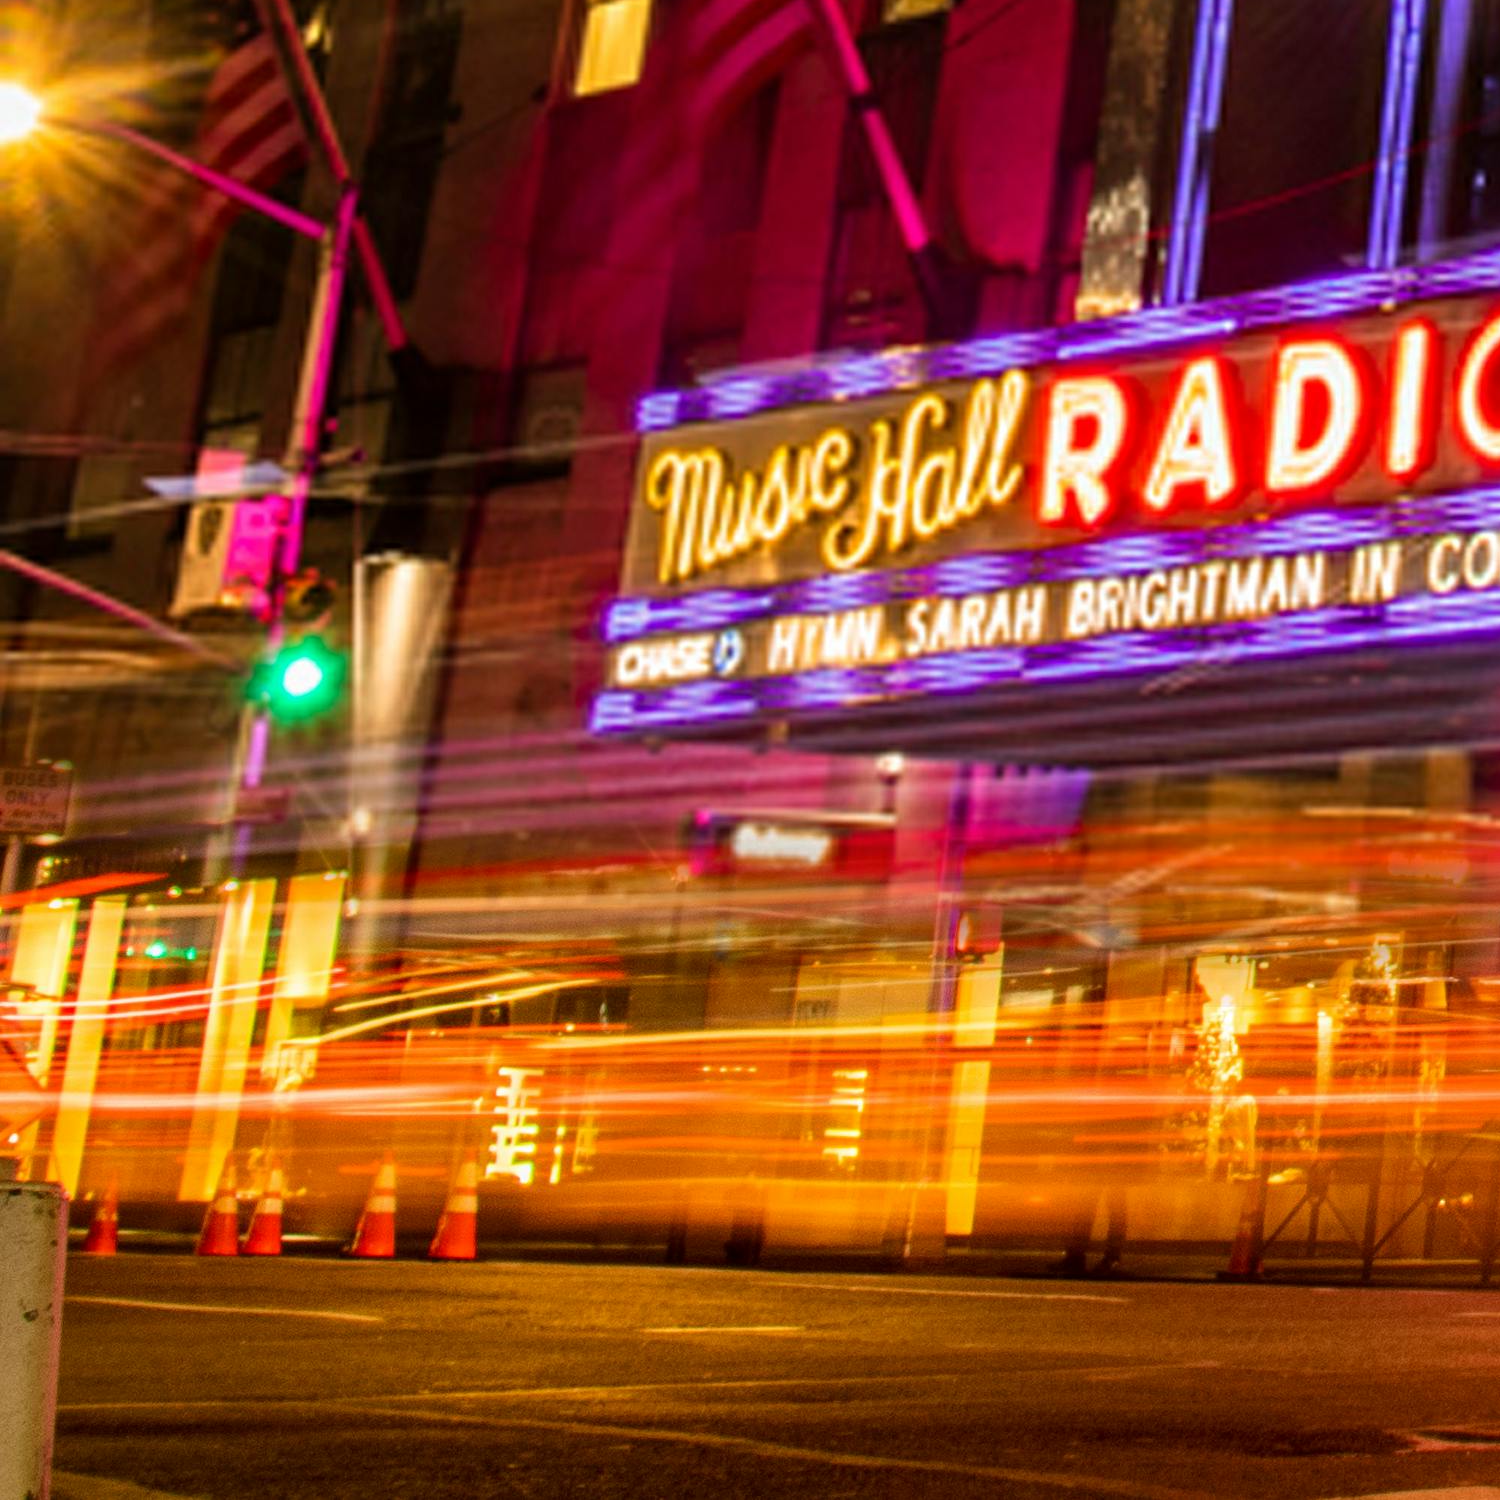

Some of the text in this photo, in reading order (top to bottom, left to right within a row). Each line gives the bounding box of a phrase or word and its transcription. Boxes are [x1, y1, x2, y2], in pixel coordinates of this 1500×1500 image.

[646, 424, 851, 583] Music
[821, 367, 1031, 572] Hall
[905, 583, 1047, 656] SARAH
[1064, 552, 1325, 638] BRIGHTMAN
[1348, 541, 1402, 602] IN
